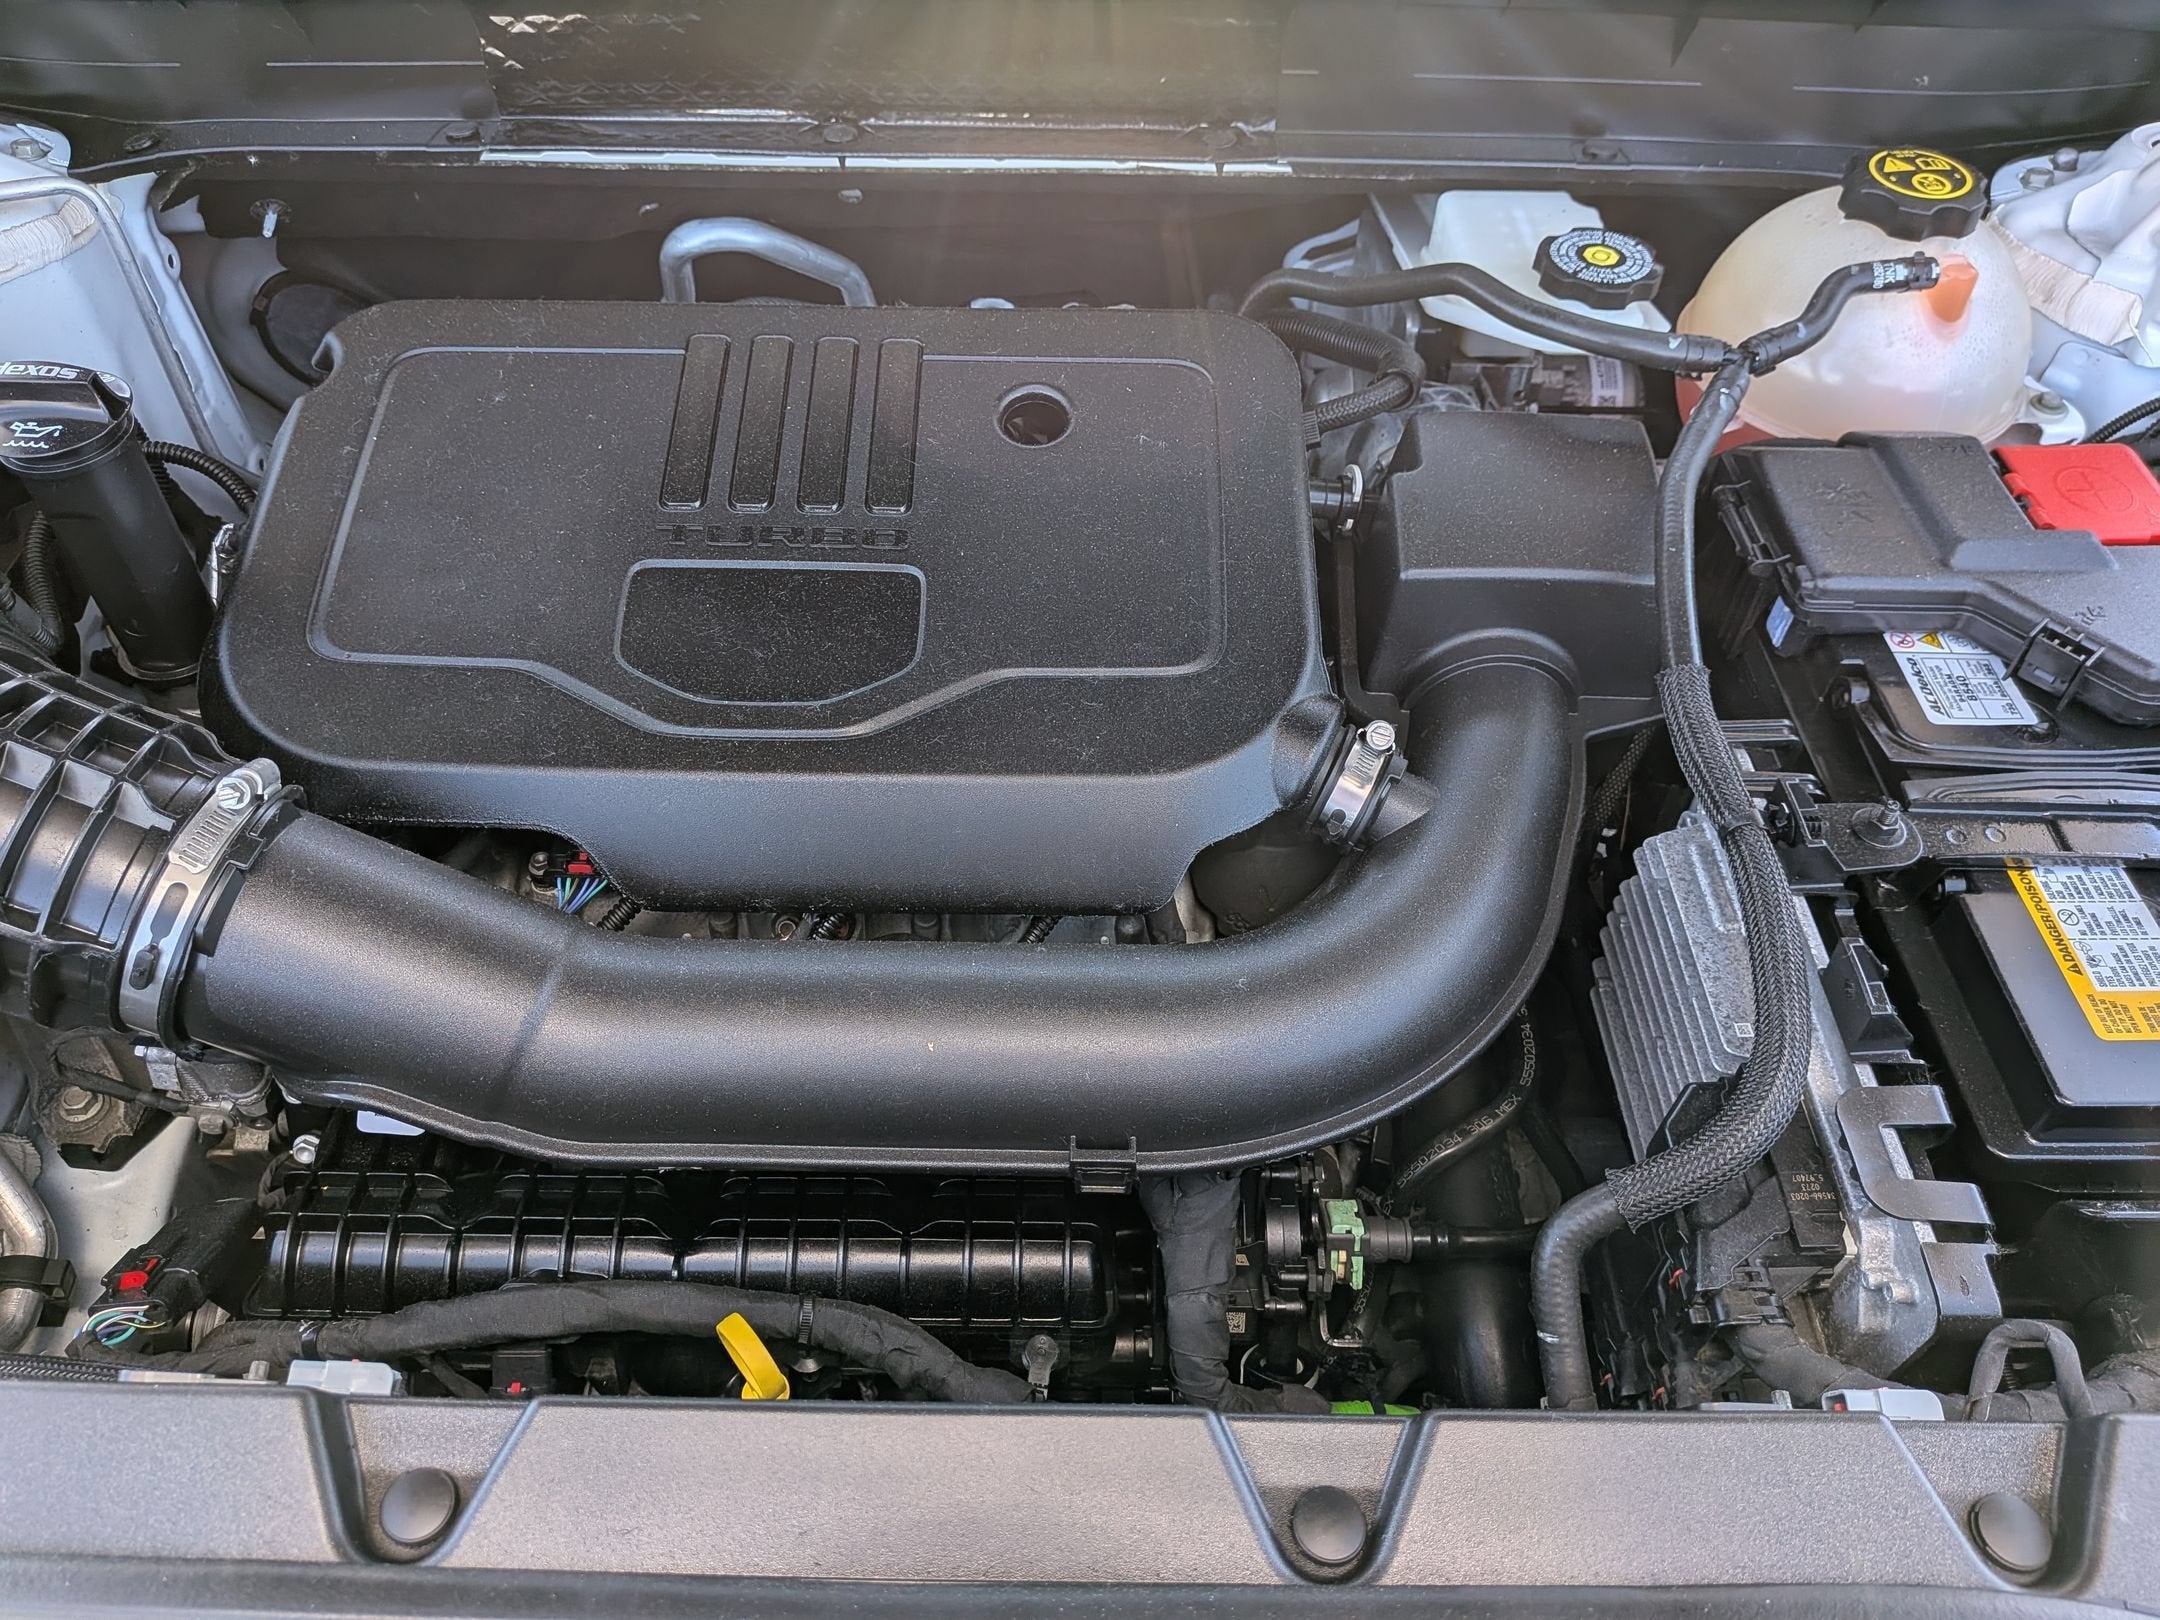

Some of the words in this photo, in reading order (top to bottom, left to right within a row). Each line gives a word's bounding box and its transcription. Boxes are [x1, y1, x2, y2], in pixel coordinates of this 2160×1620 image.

[656, 524, 911, 550] TURBO
[1906, 657, 1944, 716] ACDelco
[1520, 1023, 1536, 1087] 55502034
[1397, 1134, 1463, 1189] 55502034
[1466, 1116, 1494, 1136] 306
[1494, 1094, 1522, 1118] MEX
